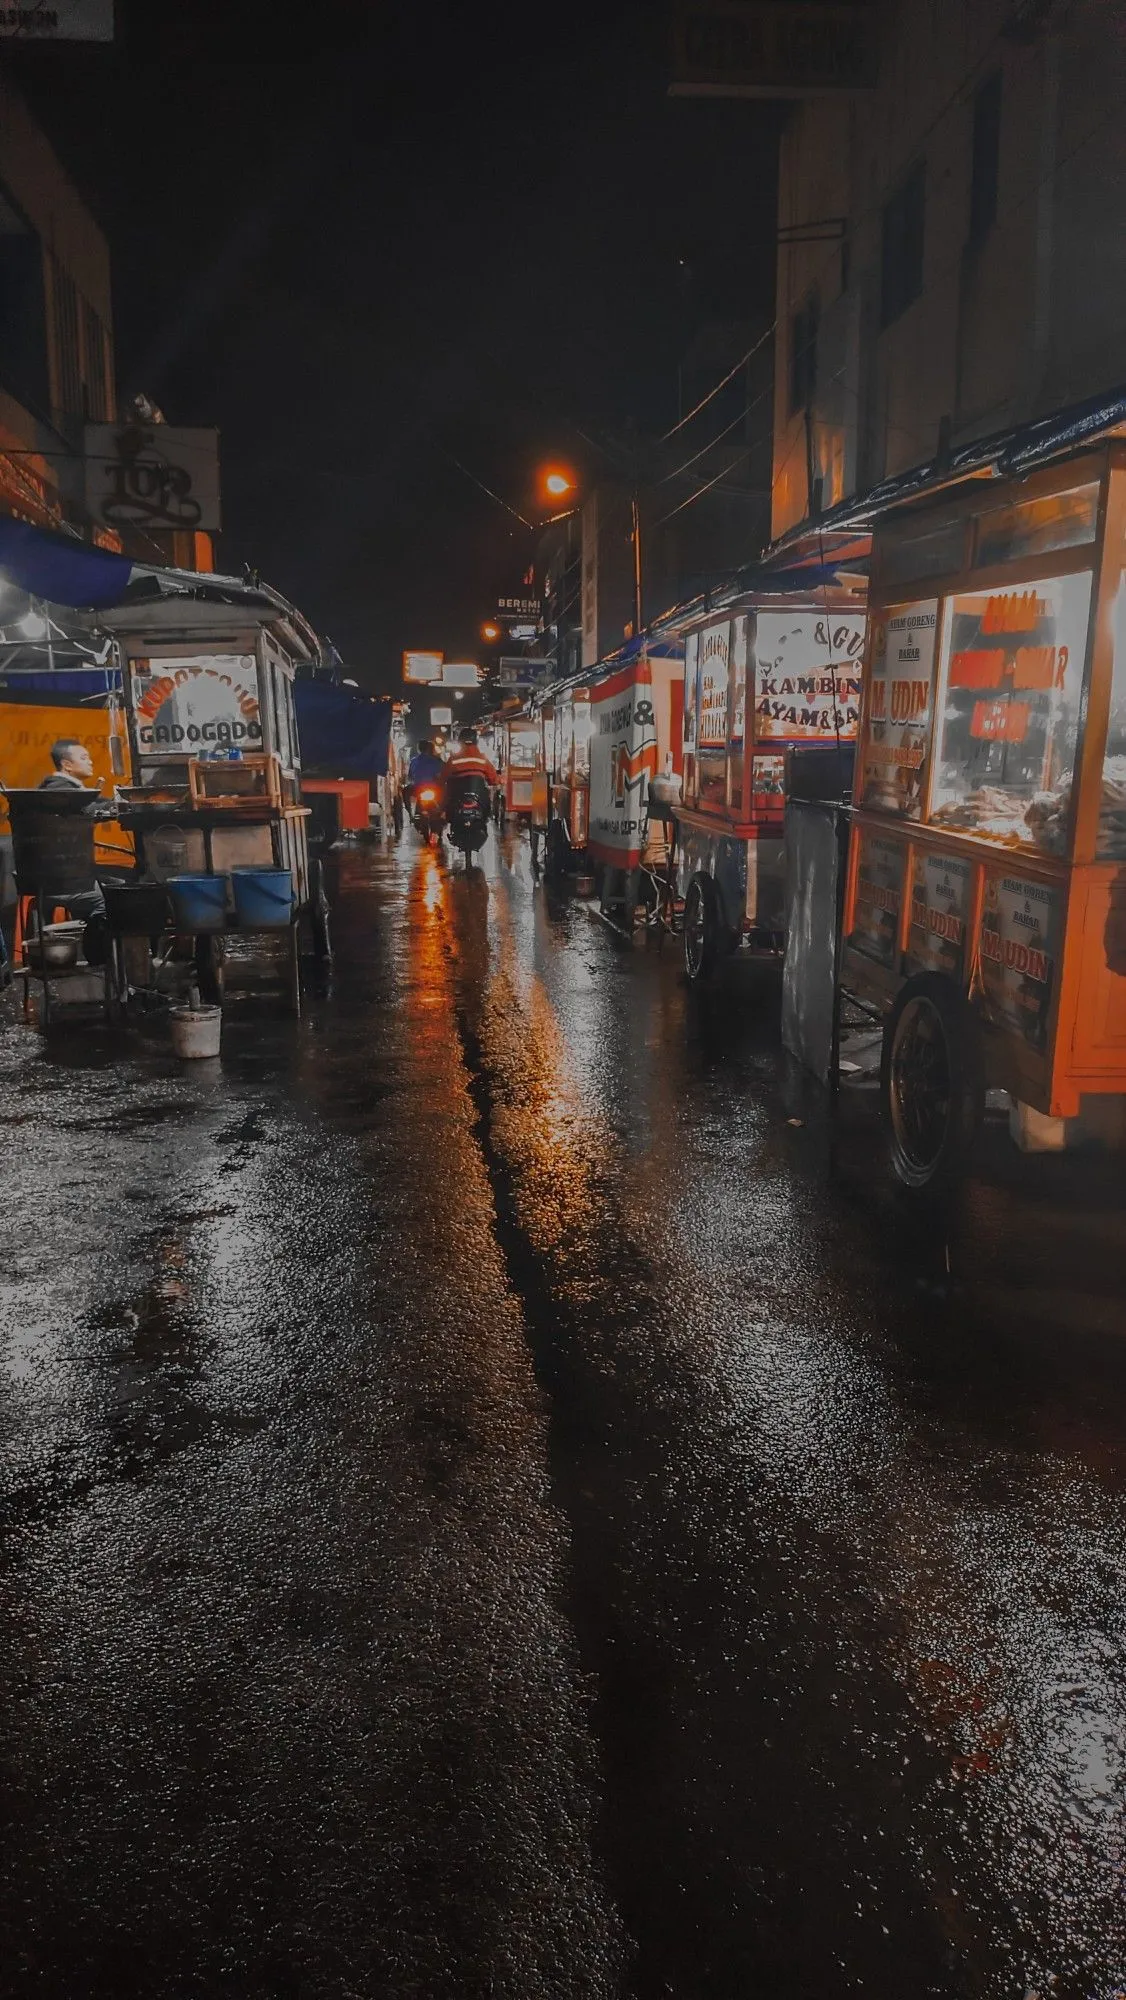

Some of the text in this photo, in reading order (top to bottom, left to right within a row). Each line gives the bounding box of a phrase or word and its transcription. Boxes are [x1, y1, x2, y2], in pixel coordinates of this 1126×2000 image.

[907, 615, 936, 628] GORENG
[890, 680, 929, 721] UDIN
[1002, 939, 1049, 984] UDIN
